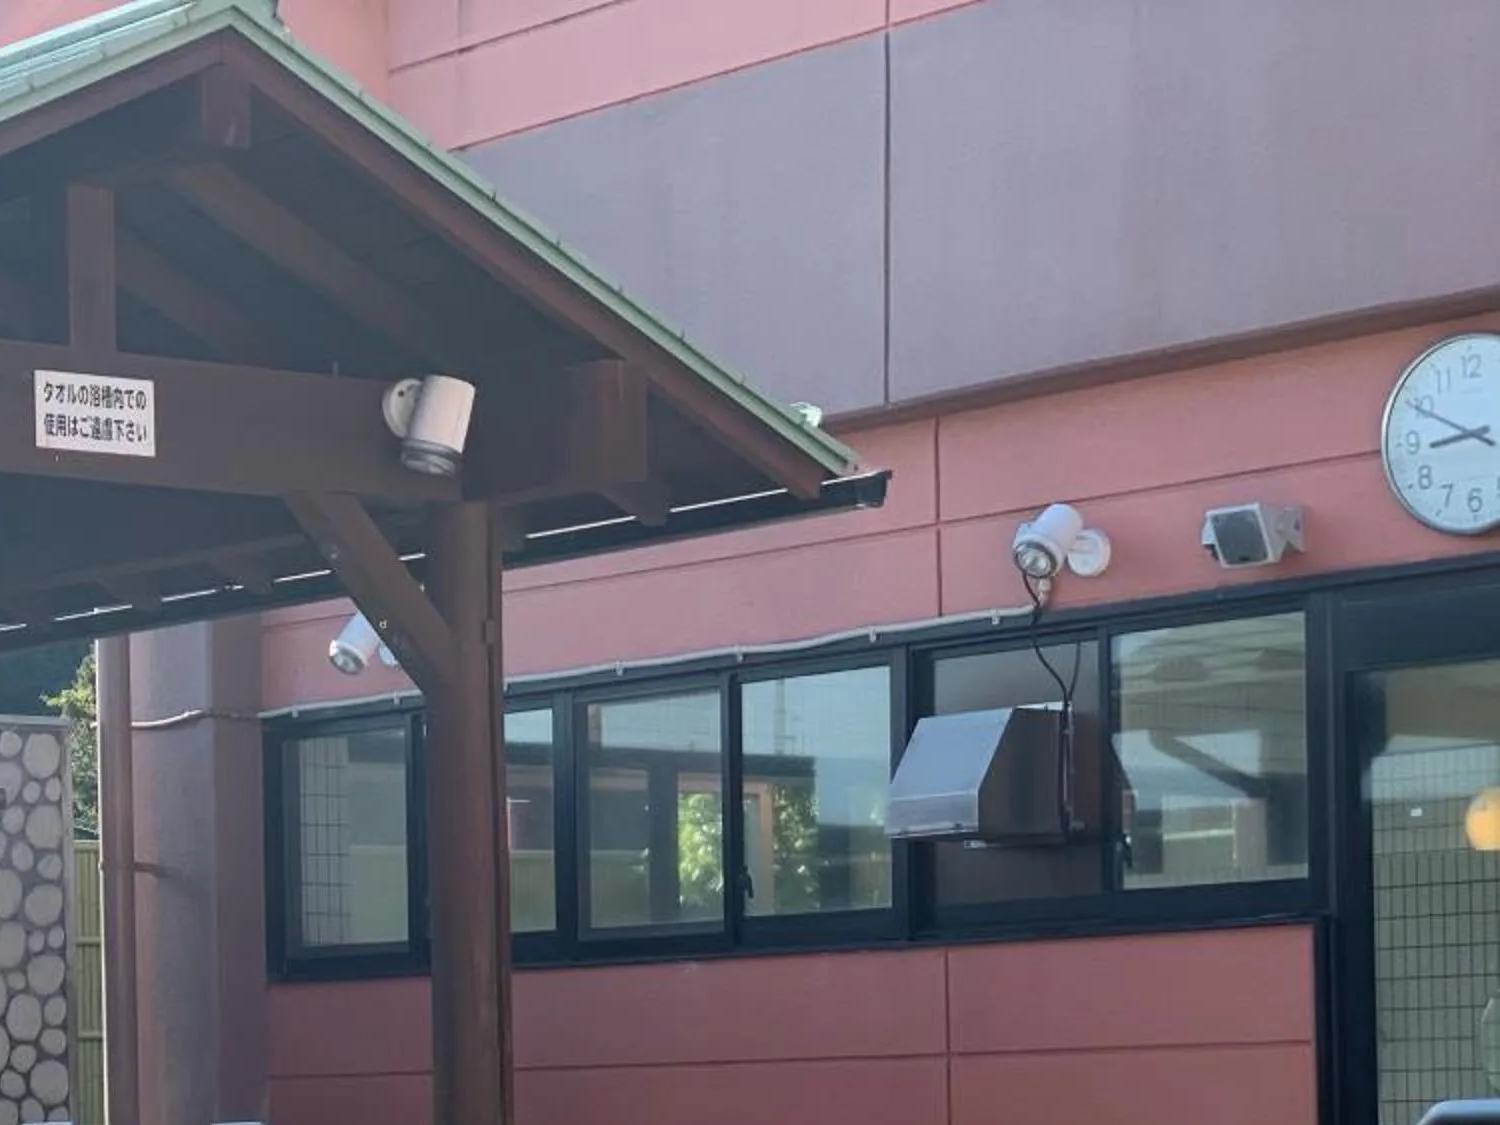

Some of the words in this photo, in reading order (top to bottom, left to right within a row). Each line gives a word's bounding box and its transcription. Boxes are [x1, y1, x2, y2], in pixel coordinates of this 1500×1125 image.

[1461, 354, 1482, 378] 12
[1437, 367, 1451, 392] 11
[43, 382, 147, 410] タオルの浴槽内での
[43, 413, 147, 443] 使用はご遠慮下さい
[1405, 430, 1420, 455] 9
[1418, 465, 1432, 490] 8
[1440, 484, 1453, 508] 7
[1467, 487, 1483, 513] 6
